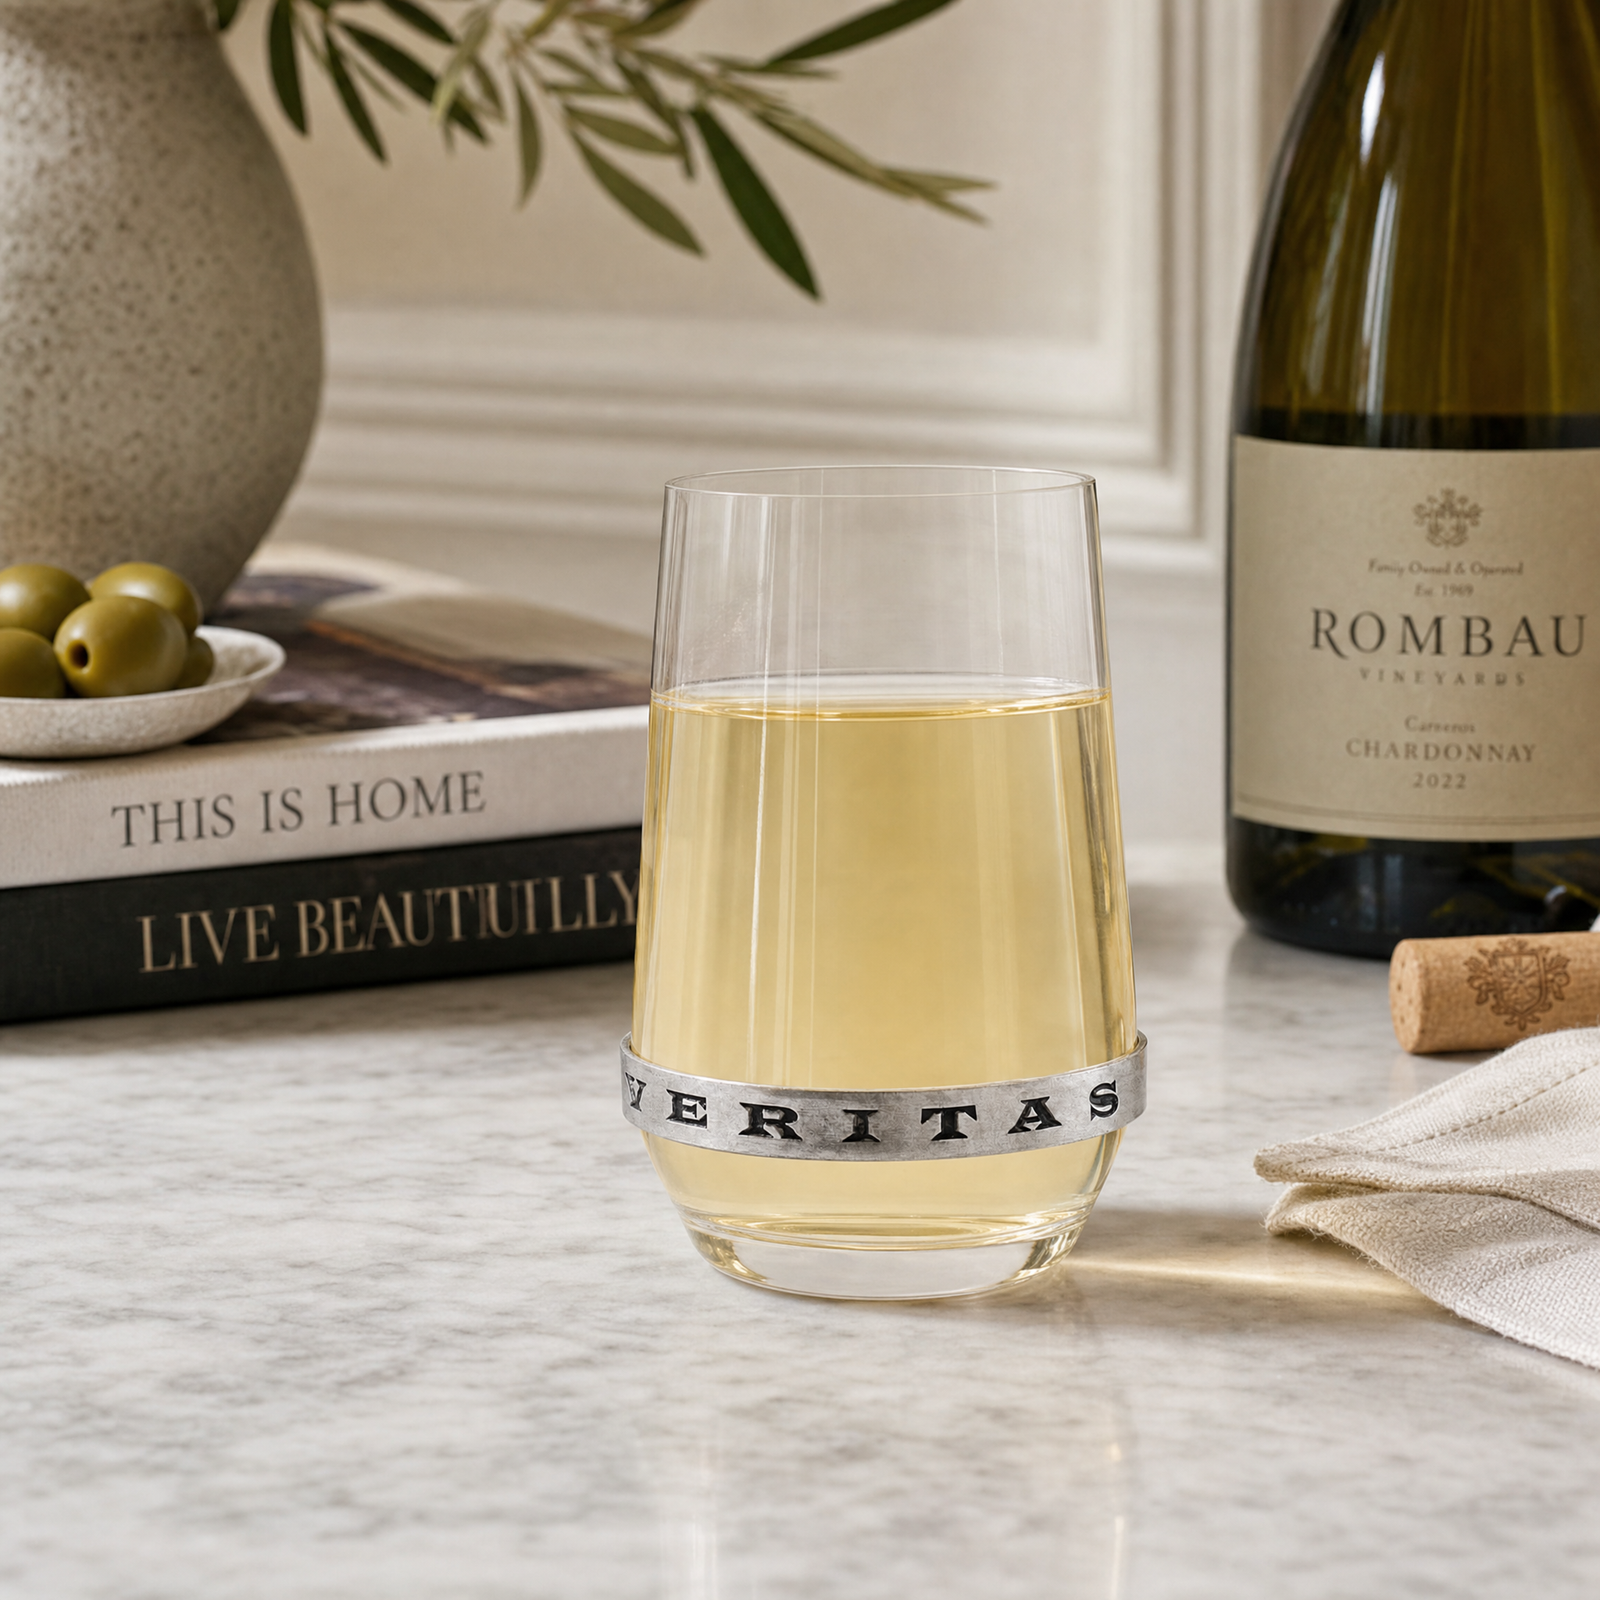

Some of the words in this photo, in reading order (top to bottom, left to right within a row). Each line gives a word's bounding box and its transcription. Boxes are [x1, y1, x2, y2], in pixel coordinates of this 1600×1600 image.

[1453, 560, 1466, 576] &
[1311, 607, 1587, 659] ROMBAU
[1359, 667, 1526, 687] VINEYARDS
[1346, 737, 1536, 763] CHARDONNAY
[1412, 771, 1467, 790] 2022
[111, 794, 236, 848] THIS
[260, 787, 305, 834] IS
[327, 770, 486, 826] HOME
[136, 904, 280, 974] LIVE
[625, 1072, 1120, 1143] VERITAS
